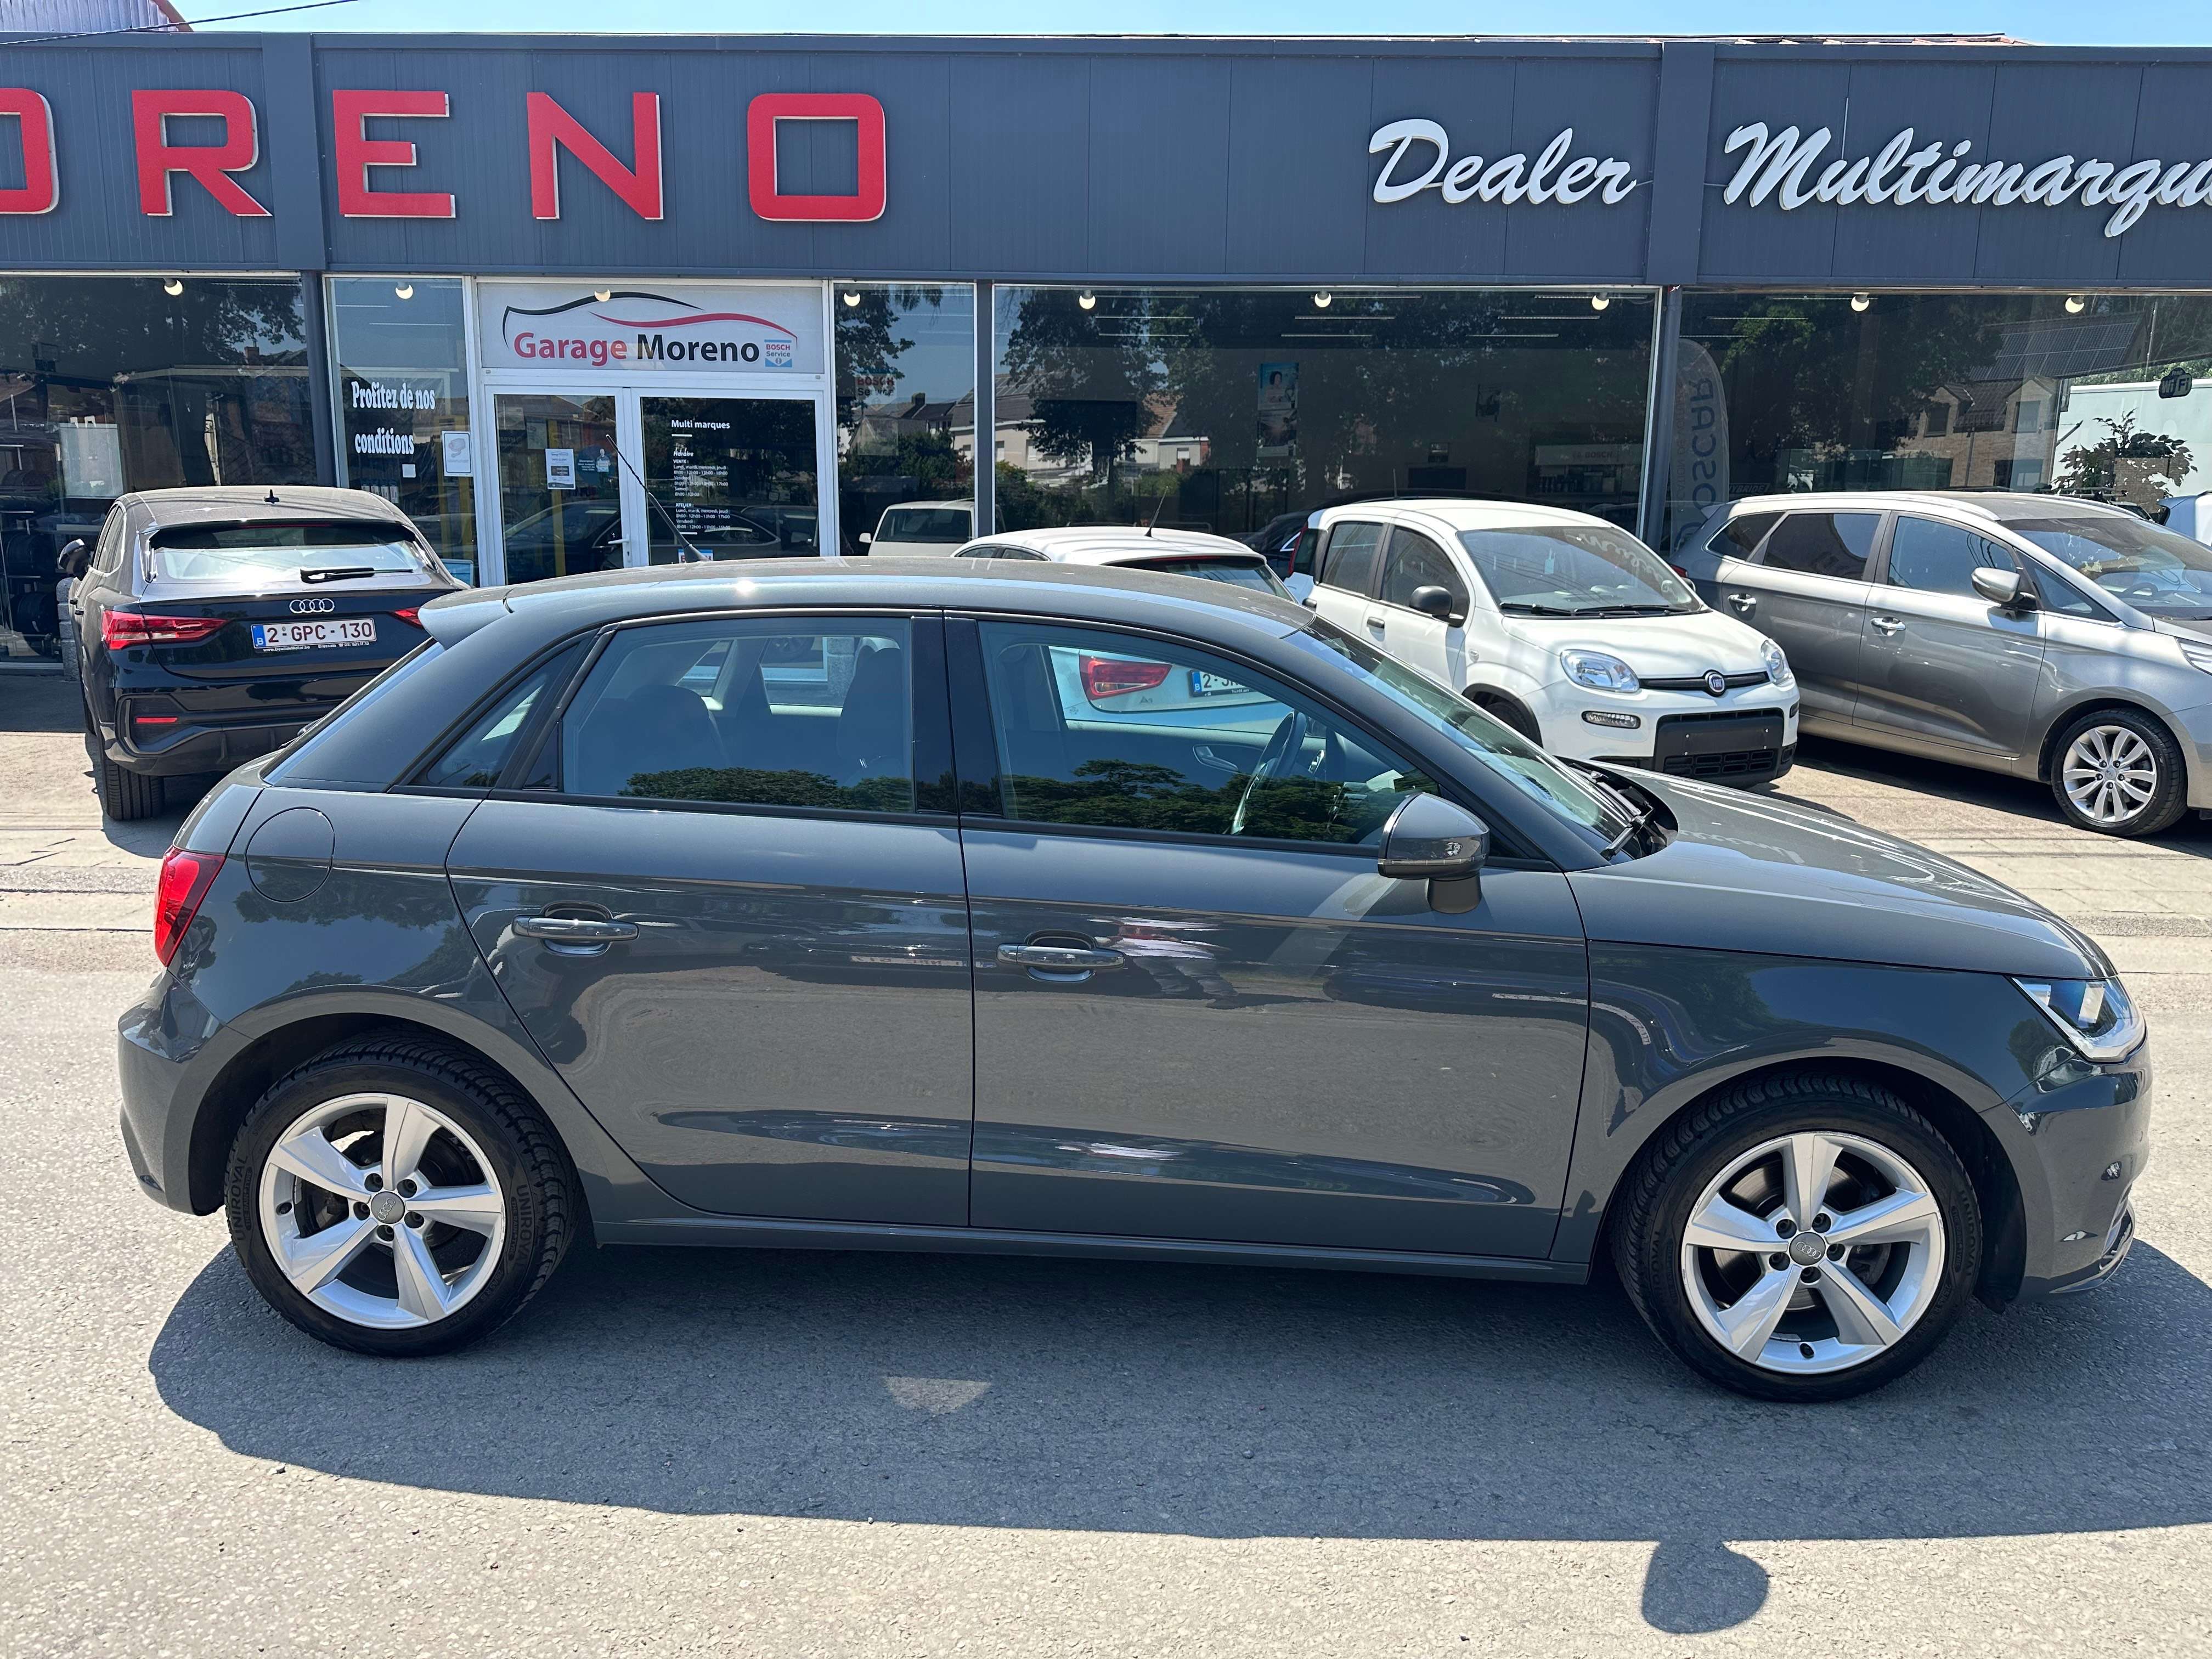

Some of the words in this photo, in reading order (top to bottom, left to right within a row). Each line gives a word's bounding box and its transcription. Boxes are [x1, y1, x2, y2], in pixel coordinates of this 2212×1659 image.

[1369, 119, 1637, 205] Dealer
[1724, 122, 2212, 238] Multimarqu
[514, 332, 627, 366] Garage
[637, 334, 760, 362] Moreno
[857, 376, 894, 385] BOSCH
[858, 387, 894, 396] Seice
[351, 381, 397, 409] Profitez
[400, 382, 413, 409] de
[415, 389, 435, 409] nos
[695, 422, 730, 430] marques
[355, 428, 414, 454] conditions
[267, 622, 373, 642] 2-GPC-130
[231, 1156, 247, 1240] UNIROYAL
[511, 1183, 532, 1274] UNIROYAL
